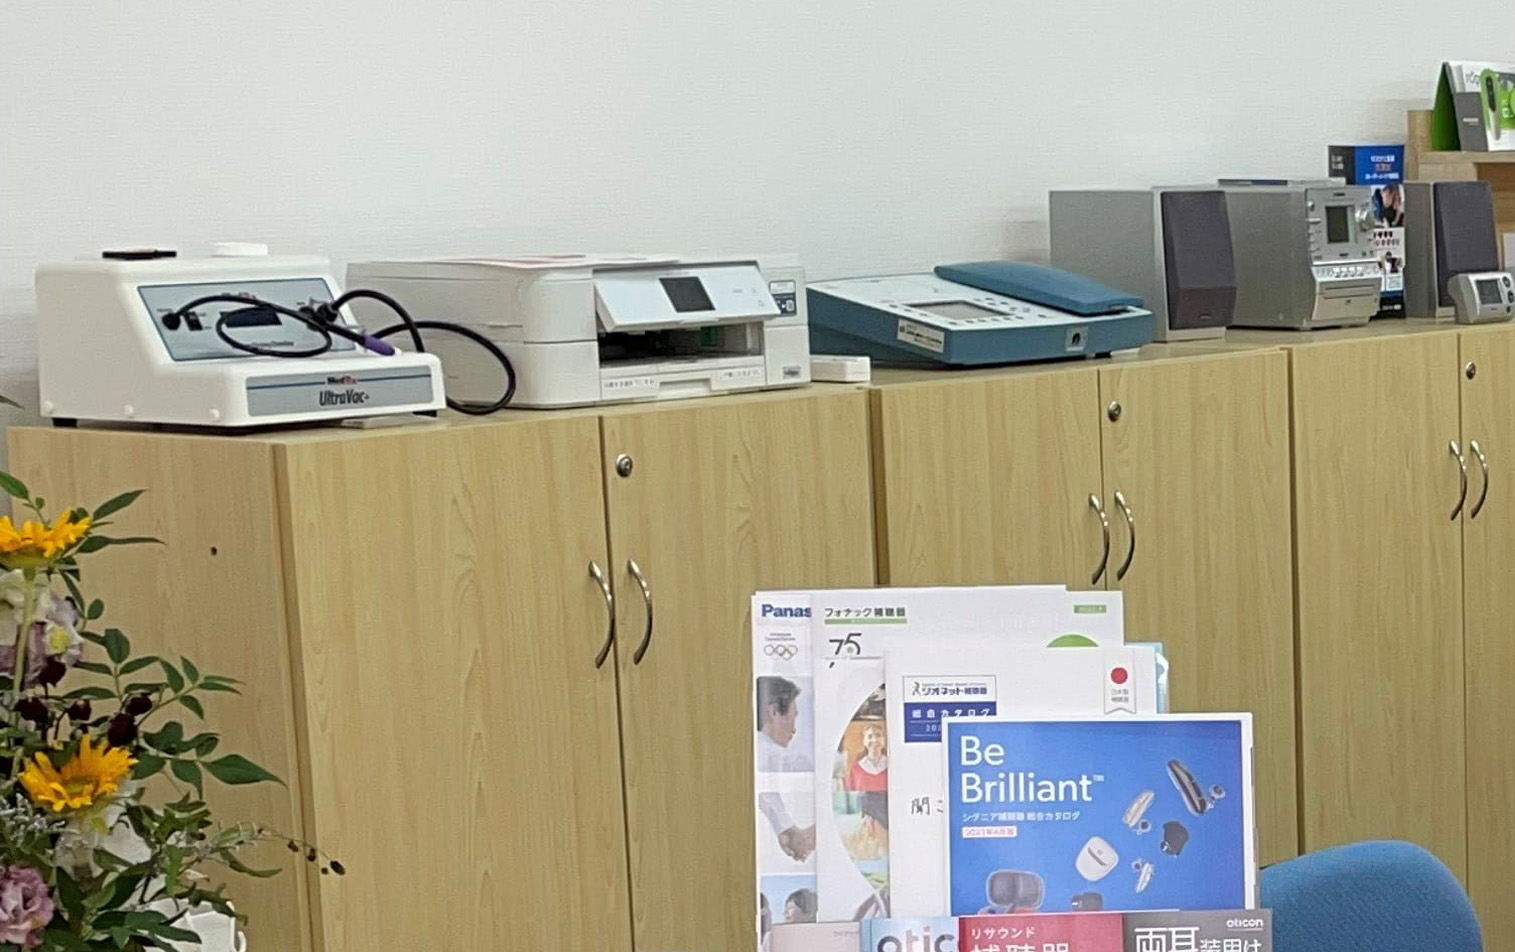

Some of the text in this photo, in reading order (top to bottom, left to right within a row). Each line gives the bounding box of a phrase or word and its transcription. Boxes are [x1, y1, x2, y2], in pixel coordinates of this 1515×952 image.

[319, 388, 371, 406] UltraVac+
[960, 735, 1005, 766] Be
[1226, 918, 1264, 929] oticon
[971, 926, 1036, 940] リサウンド
